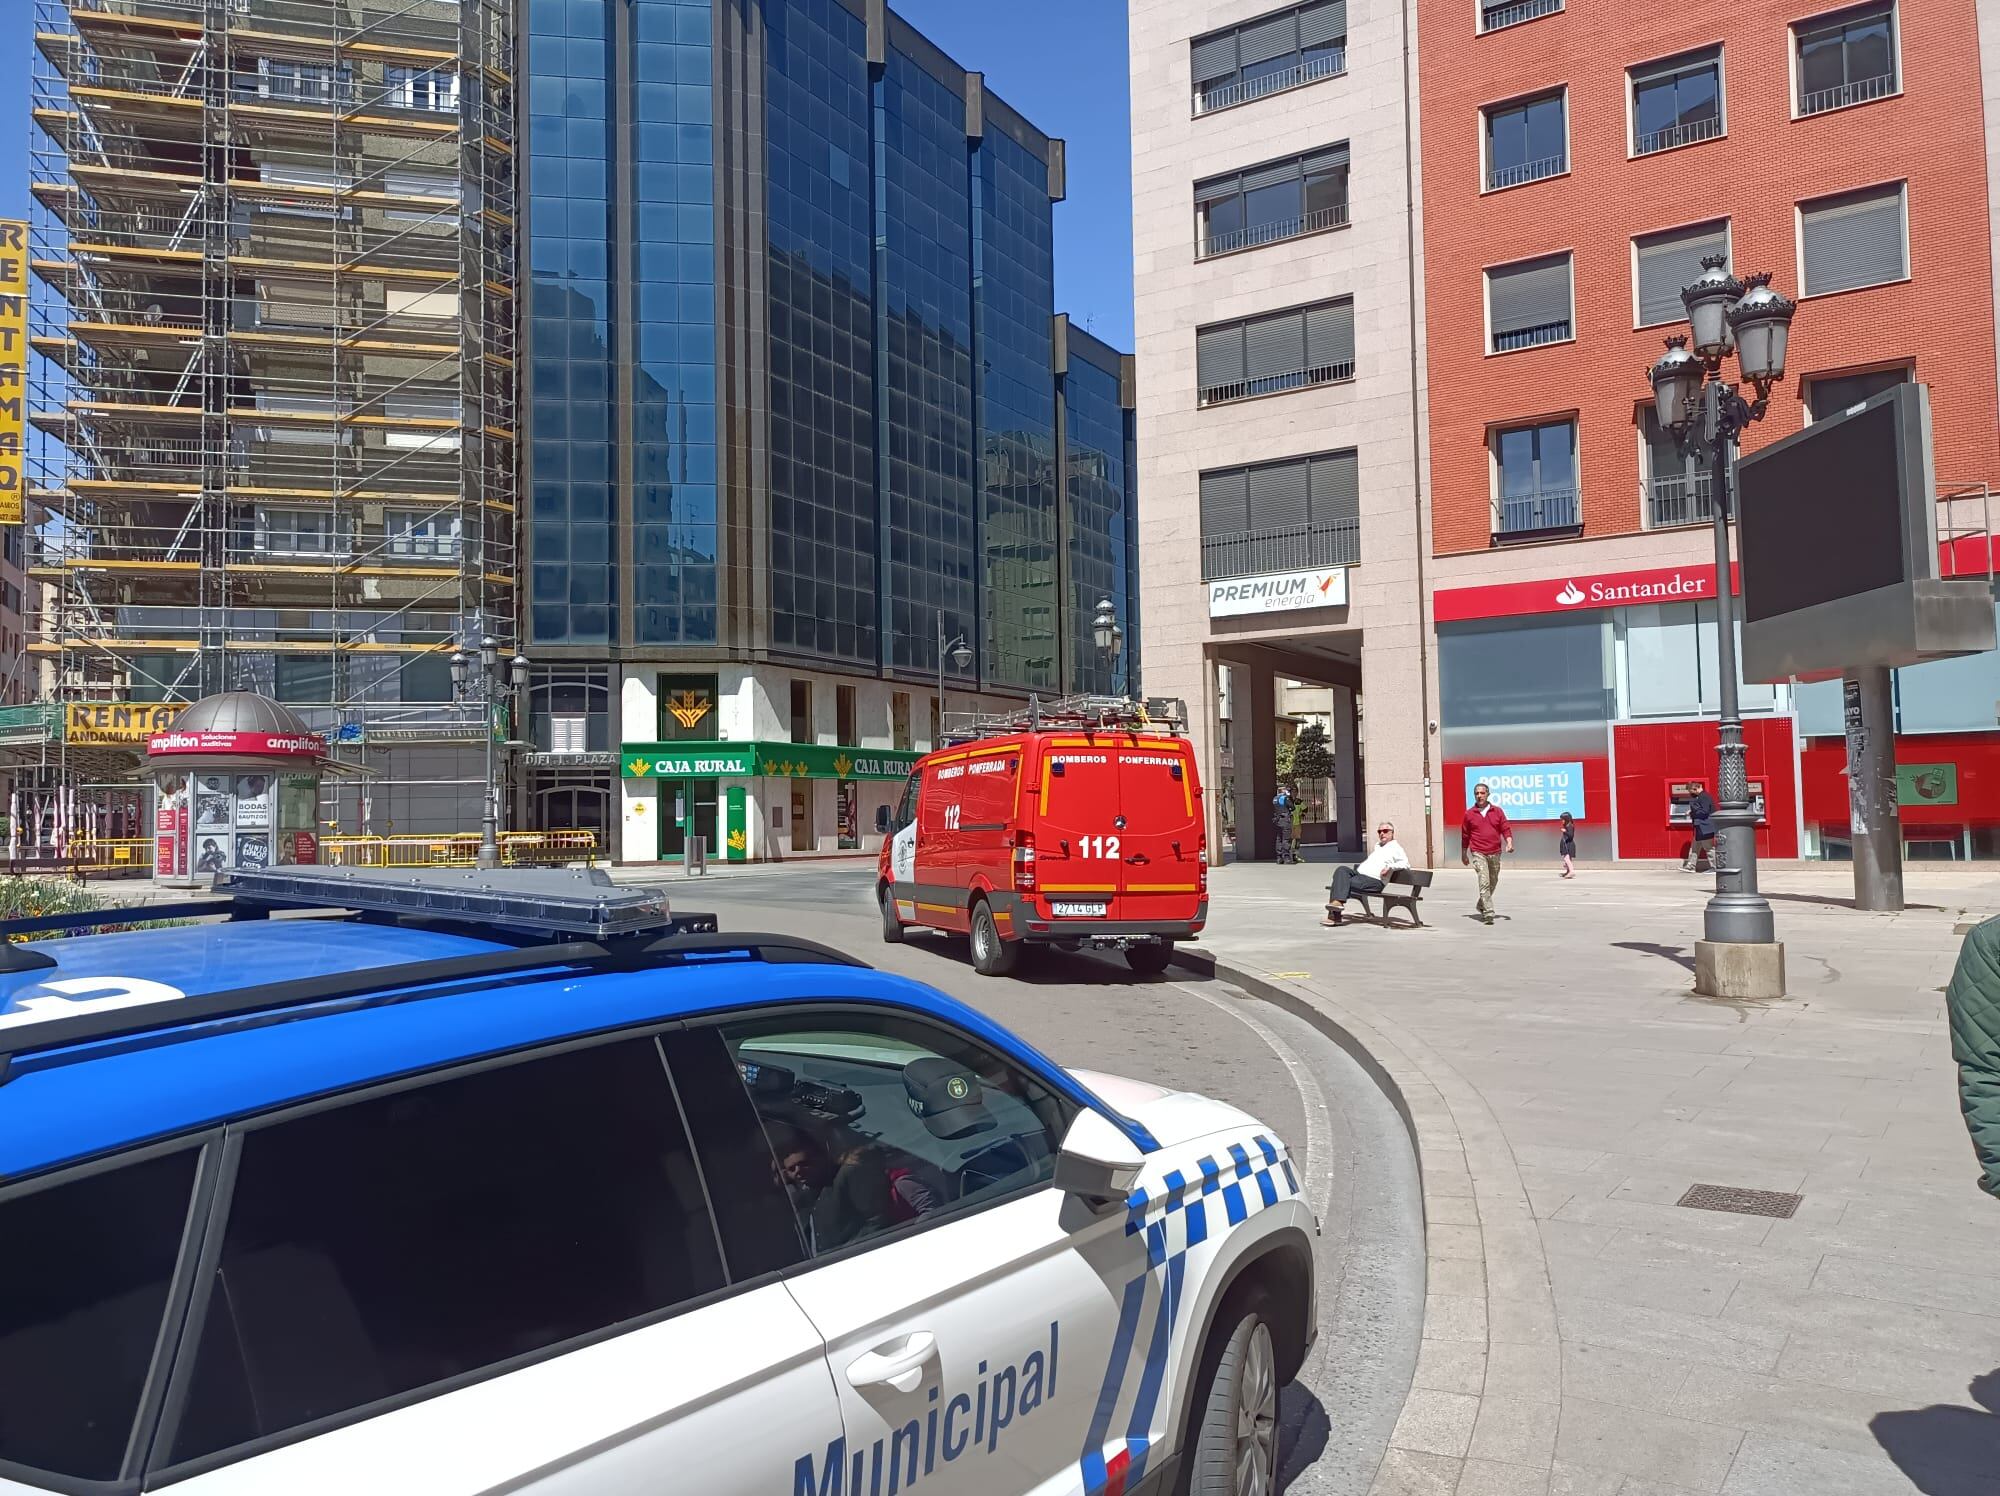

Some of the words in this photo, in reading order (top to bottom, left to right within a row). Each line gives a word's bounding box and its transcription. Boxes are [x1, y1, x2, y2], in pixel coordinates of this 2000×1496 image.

[1212, 578, 1307, 602] PREMIUM
[1590, 574, 1705, 601] Santander
[1265, 592, 1315, 608] energía
[72, 706, 182, 730] RENTA
[151, 734, 198, 750] amplifon
[267, 737, 320, 752] amplifon
[575, 755, 616, 764] PLAZA
[655, 760, 692, 773] CAJA
[694, 760, 746, 772] RURAL
[854, 758, 880, 774] CAJA
[1051, 755, 1107, 763] BOMBEROS
[1118, 756, 1180, 765] PONFERRADA
[937, 765, 964, 780] BOMBEROS
[968, 759, 1006, 775] PONFERRADA
[1547, 771, 1568, 787] TÚ
[1488, 791, 1545, 806] ORQUE
[1547, 790, 1568, 804] TE
[944, 804, 960, 830] 112
[1078, 835, 1120, 859] 112
[793, 1320, 1059, 1496] Municipal
